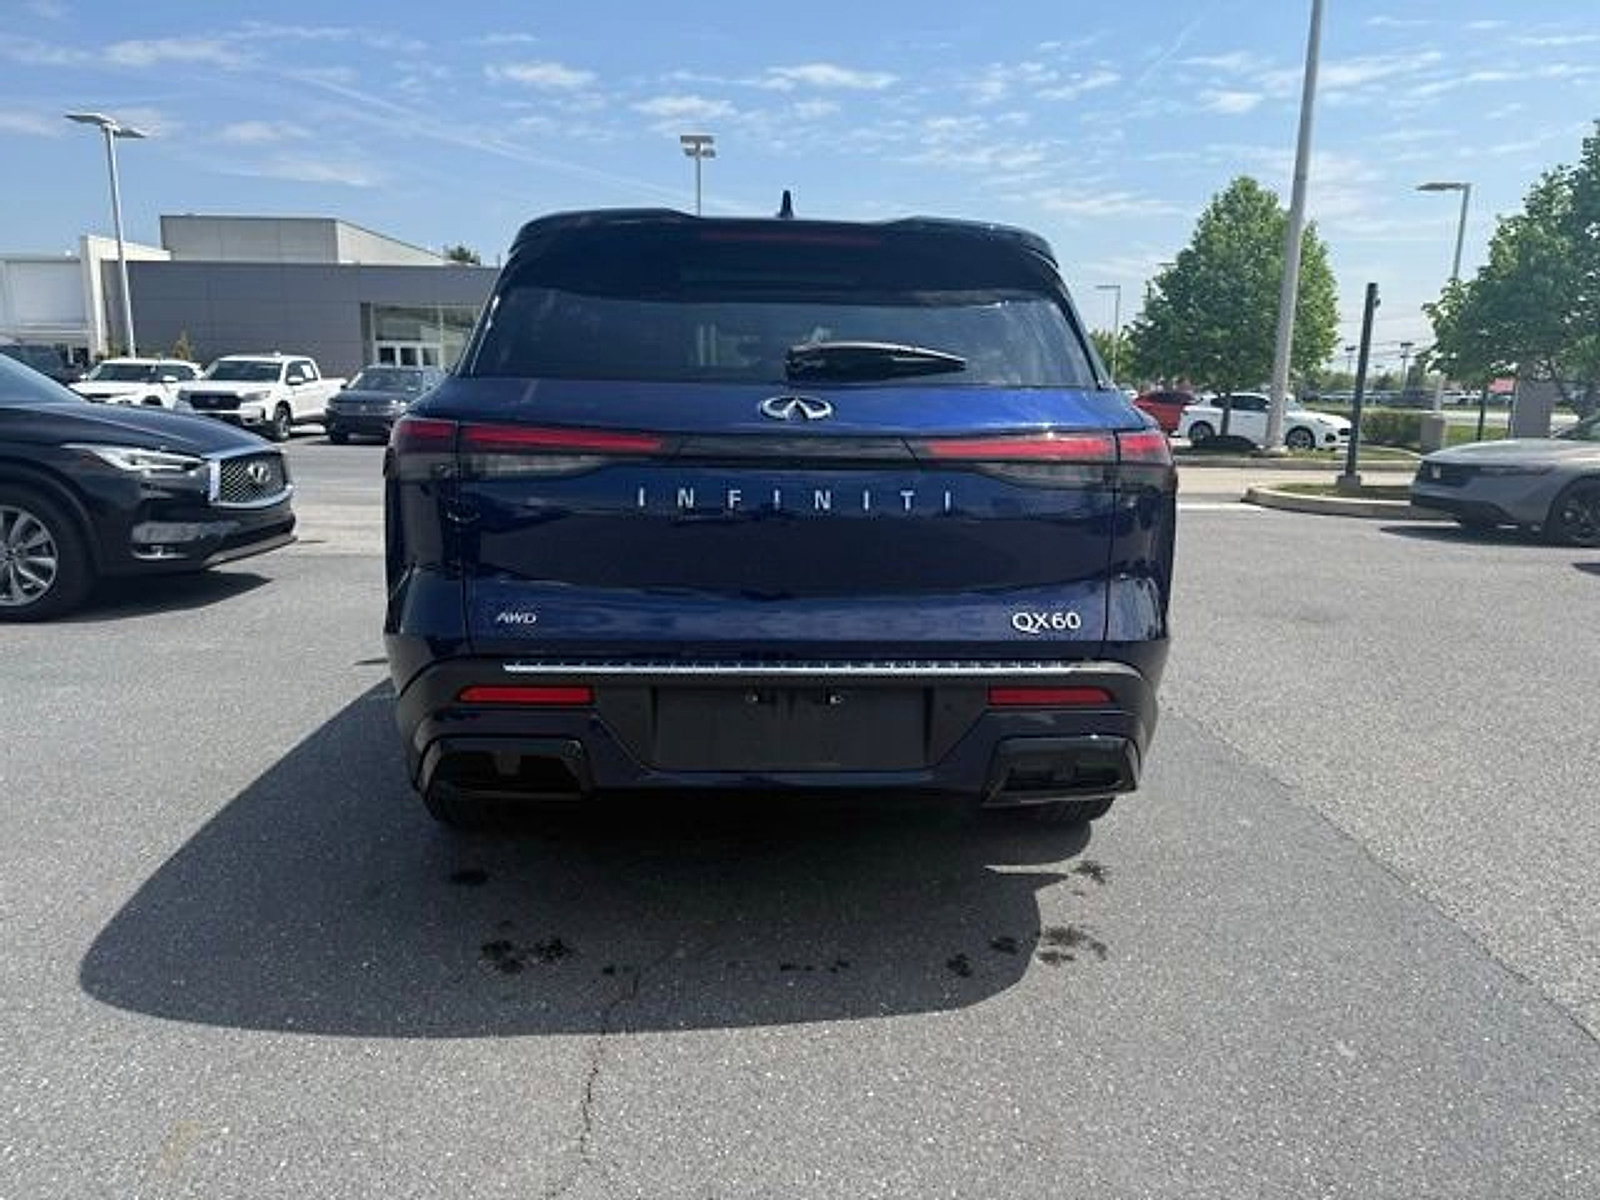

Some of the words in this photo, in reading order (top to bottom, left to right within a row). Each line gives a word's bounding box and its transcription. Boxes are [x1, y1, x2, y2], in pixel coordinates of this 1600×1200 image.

[637, 487, 952, 511] INFINITI
[495, 612, 537, 624] AWD
[1012, 612, 1081, 633] QX60
